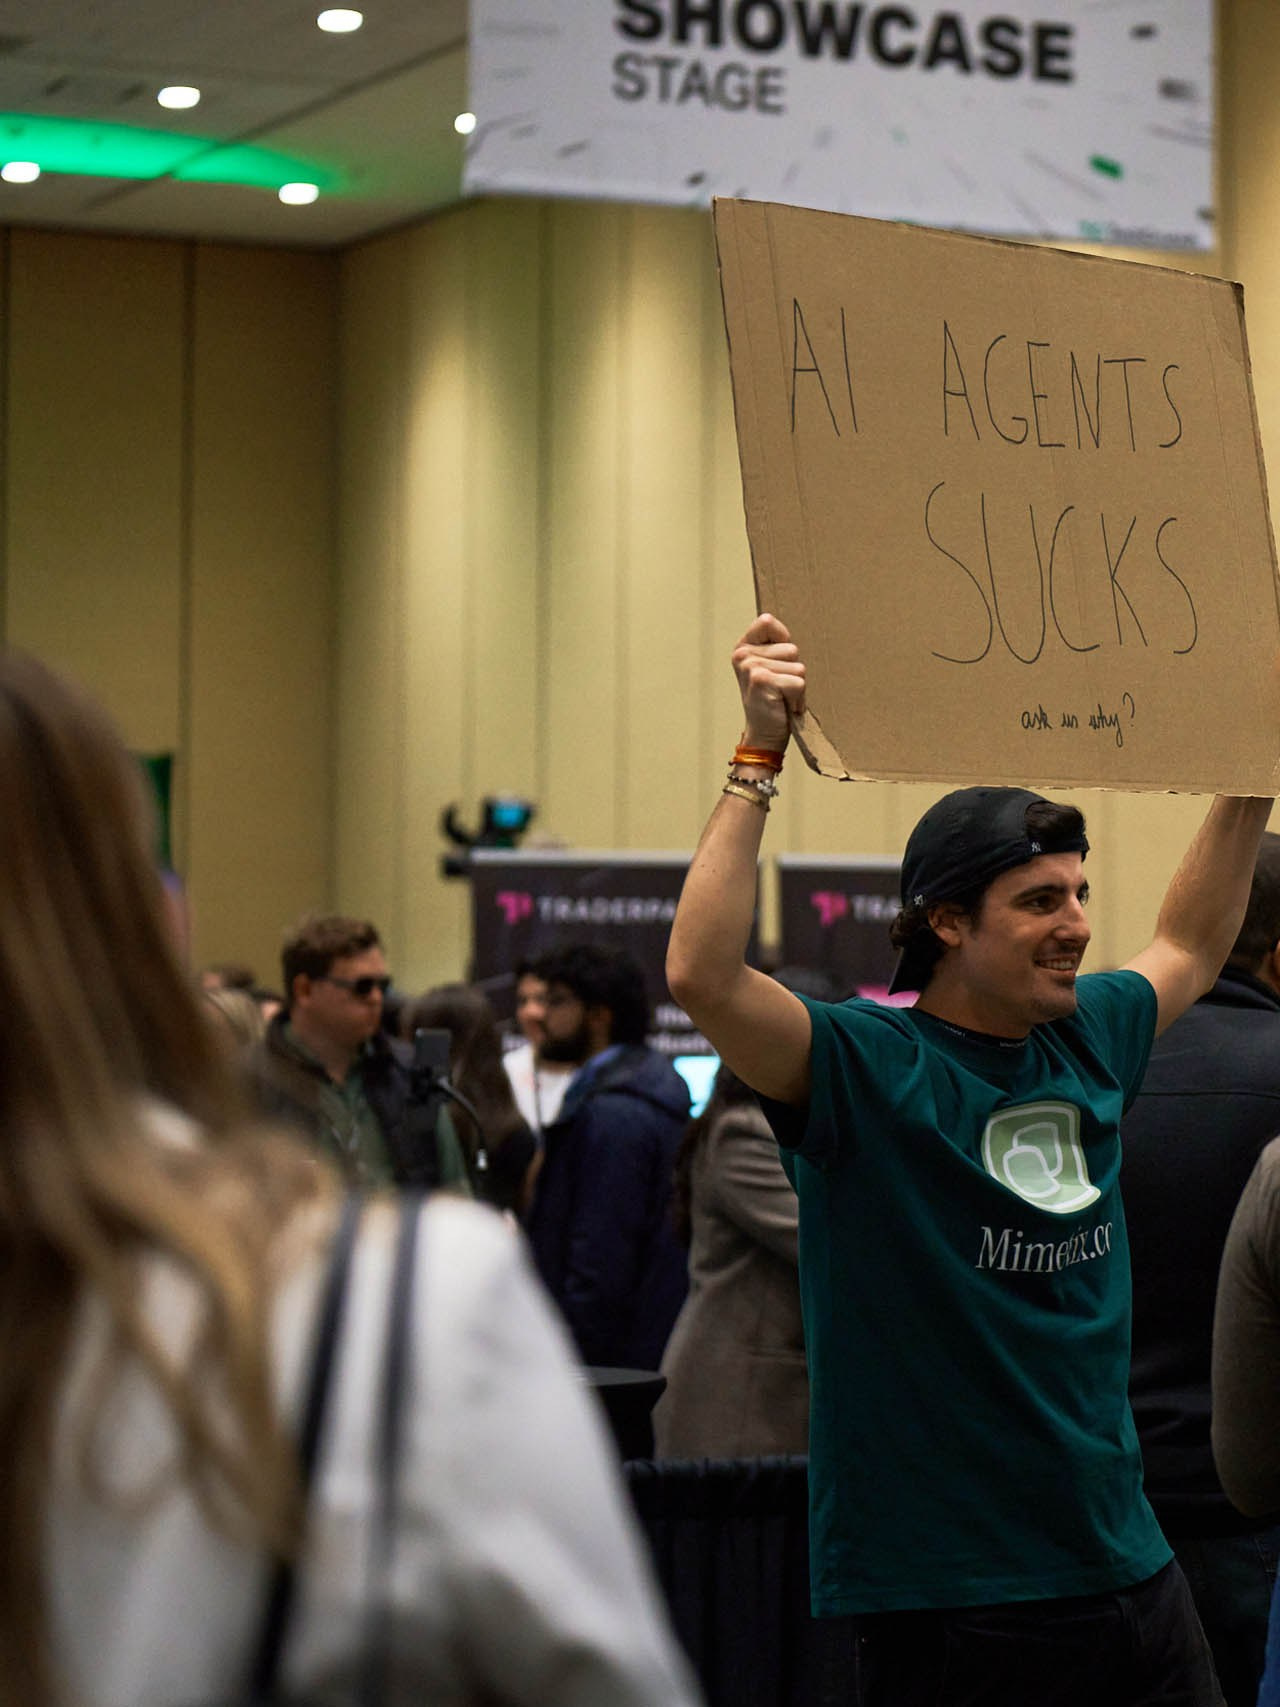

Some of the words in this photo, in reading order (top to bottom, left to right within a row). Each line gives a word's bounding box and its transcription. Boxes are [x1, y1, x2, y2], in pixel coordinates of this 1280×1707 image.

[614, 0, 1074, 83] SHOWCASE
[612, 52, 785, 115] STAGE
[790, 297, 859, 438] AI
[943, 319, 1183, 452] AGENTS
[925, 481, 1199, 665] SUCKS
[1021, 703, 1053, 730] ask
[1088, 691, 1135, 748] why?
